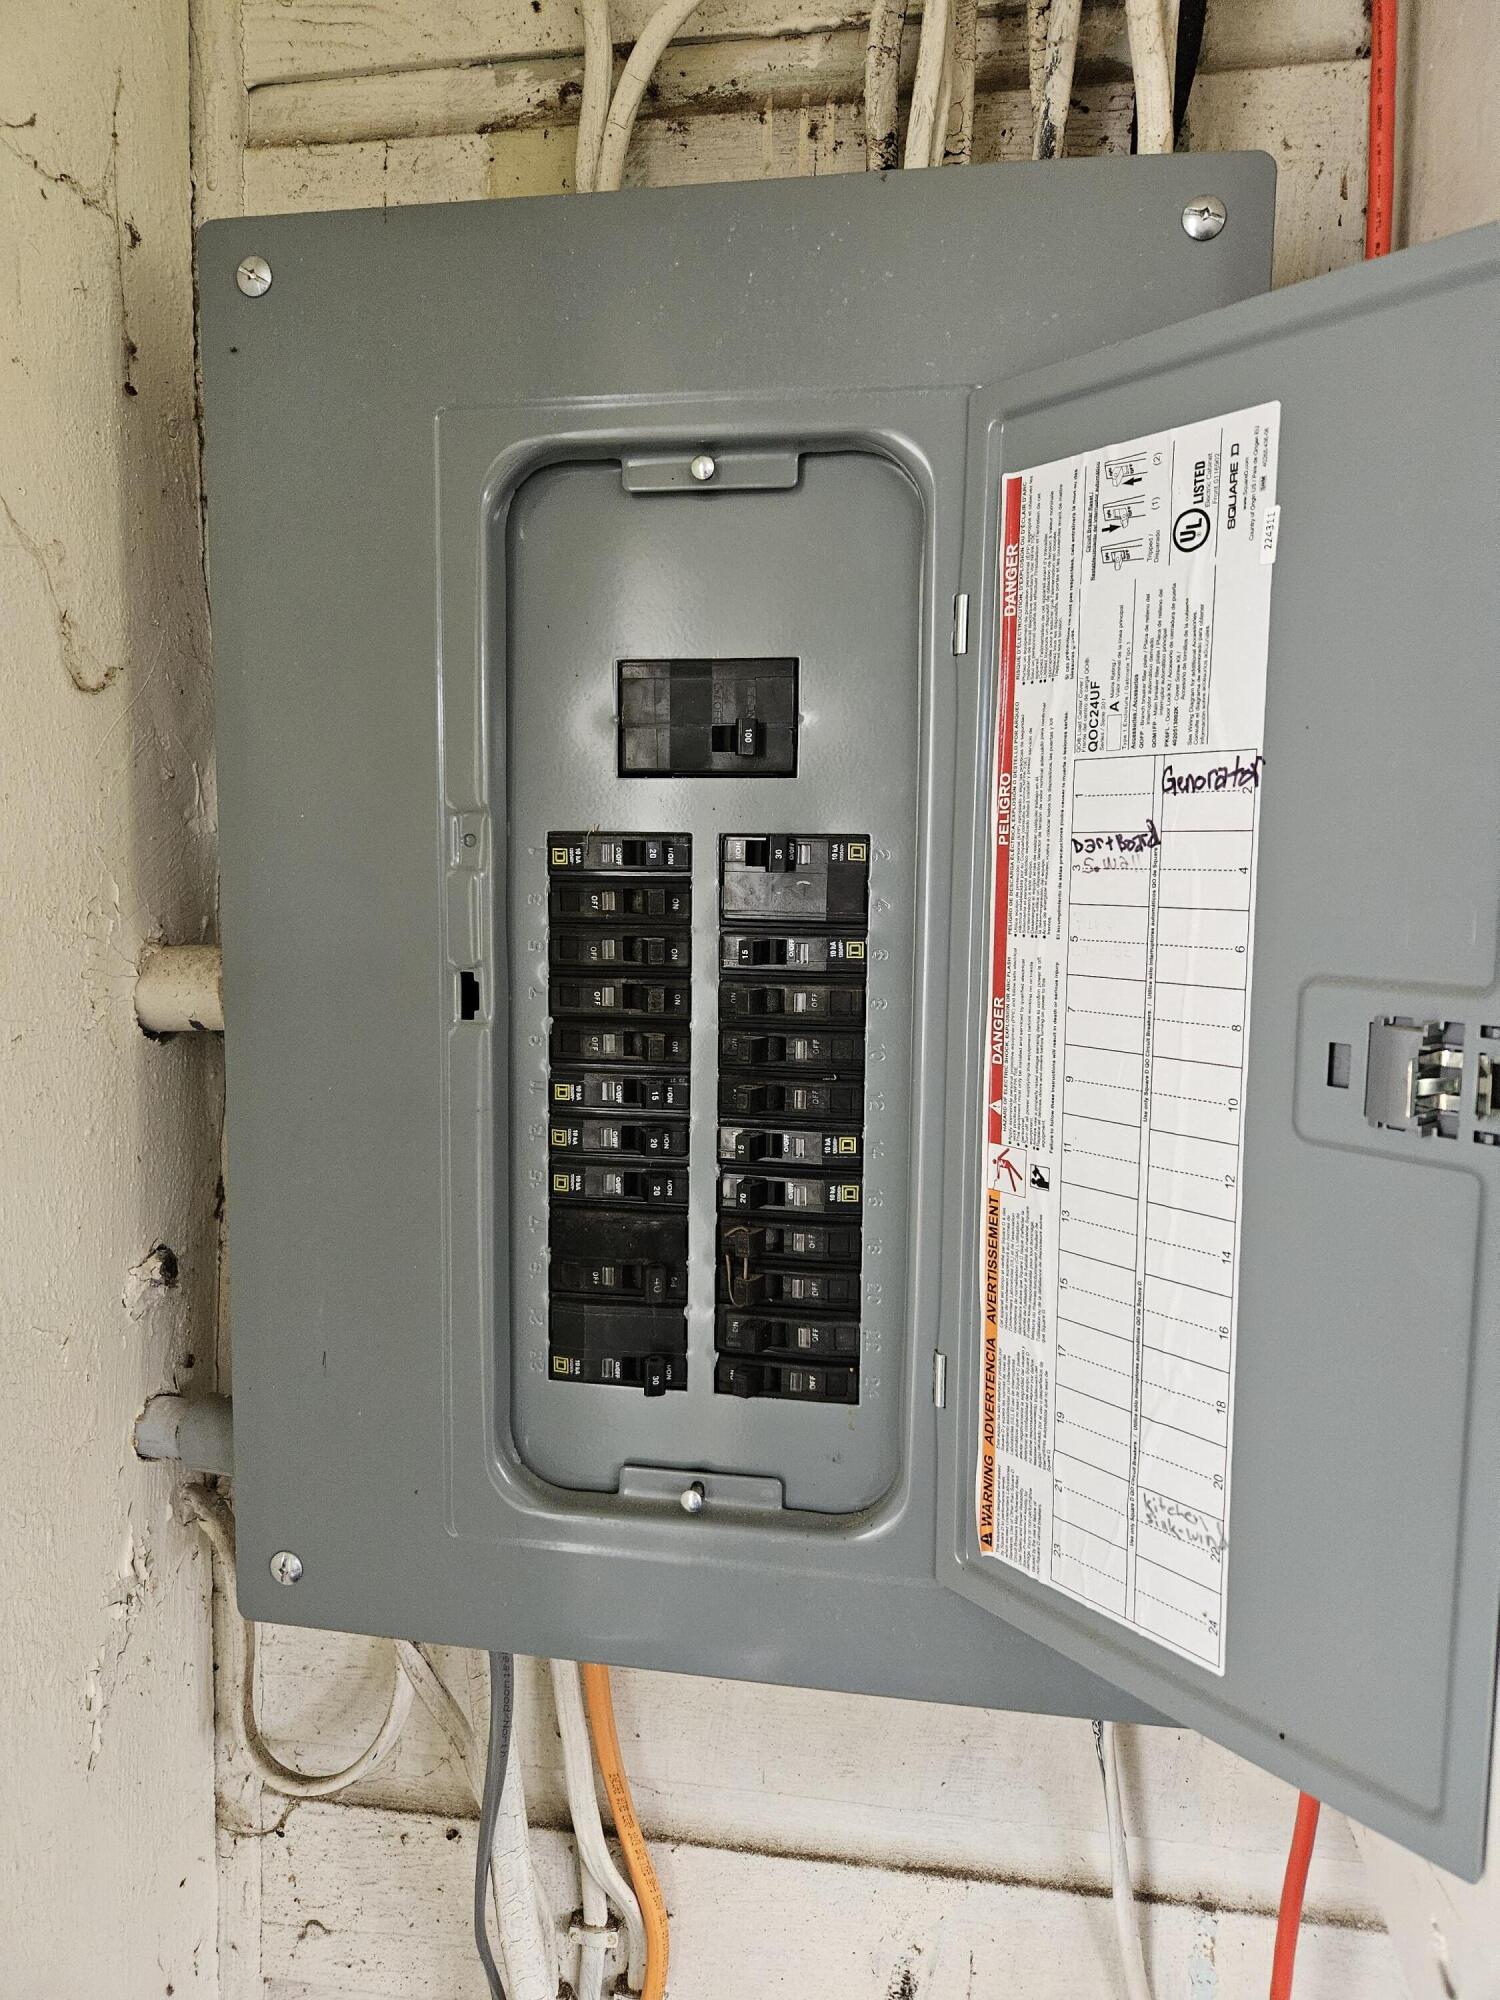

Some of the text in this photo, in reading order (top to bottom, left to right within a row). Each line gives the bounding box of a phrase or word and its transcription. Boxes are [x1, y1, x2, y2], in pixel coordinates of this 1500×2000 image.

[1153, 452, 1162, 466] (2)
[1193, 461, 1206, 504] LISTED
[1227, 443, 1239, 530] SQUARE D
[1151, 497, 1161, 510] (1)
[1180, 517, 1202, 543] UL
[1264, 512, 1276, 550] 224311
[1003, 543, 1018, 617] DANGER
[1109, 701, 1119, 712] A
[1088, 681, 1100, 752] QOC24UF
[744, 728, 753, 743] 100
[1242, 786, 1253, 794] 2
[998, 773, 1011, 846] PELIGRO
[575, 847, 581, 855] 10
[649, 848, 657, 859] 20
[775, 849, 782, 859] 30
[832, 844, 838, 853] kA
[591, 895, 599, 910] OFF
[672, 898, 680, 910] ON
[590, 946, 598, 961] OFF
[671, 948, 678, 960] ON
[742, 949, 749, 959] 15
[830, 950, 837, 958] 10
[1235, 945, 1245, 953] 6
[593, 991, 601, 1006] OFF
[673, 994, 681, 1006] ON
[730, 993, 737, 1004] ON
[992, 997, 1004, 1065] DANGER
[591, 1036, 599, 1051] OFF
[671, 1041, 679, 1052] ON
[812, 1040, 820, 1054] OFF
[1066, 1075, 1074, 1083] 9
[651, 1091, 659, 1100] 15
[1228, 1098, 1238, 1113] 10
[572, 1129, 578, 1137] 10
[650, 1138, 658, 1148] 20
[738, 1145, 745, 1154] 15
[1063, 1142, 1072, 1153] 11
[1224, 1175, 1235, 1189] 12
[653, 1185, 661, 1196] 20
[830, 1193, 836, 1201] 10
[740, 1193, 747, 1203] 20
[1062, 1209, 1070, 1223] 13
[1221, 1250, 1232, 1264] 14
[653, 1277, 662, 1293] 40
[1059, 1277, 1068, 1291] 15
[1219, 1326, 1229, 1340] 16
[1058, 1344, 1066, 1358] 17
[981, 1195, 998, 1526] WARNING ADVERTENCIA AVERTISSEMENT
[652, 1375, 660, 1385] 30
[809, 1376, 817, 1390] OFF
[1216, 1400, 1226, 1415] 18
[1057, 1412, 1065, 1424] 19
[1054, 1479, 1063, 1493] 21
[1213, 1474, 1223, 1490] 20
[1054, 1543, 1062, 1559] 23
[1210, 1547, 1221, 1563] 22
[1208, 1620, 1218, 1636] 24
